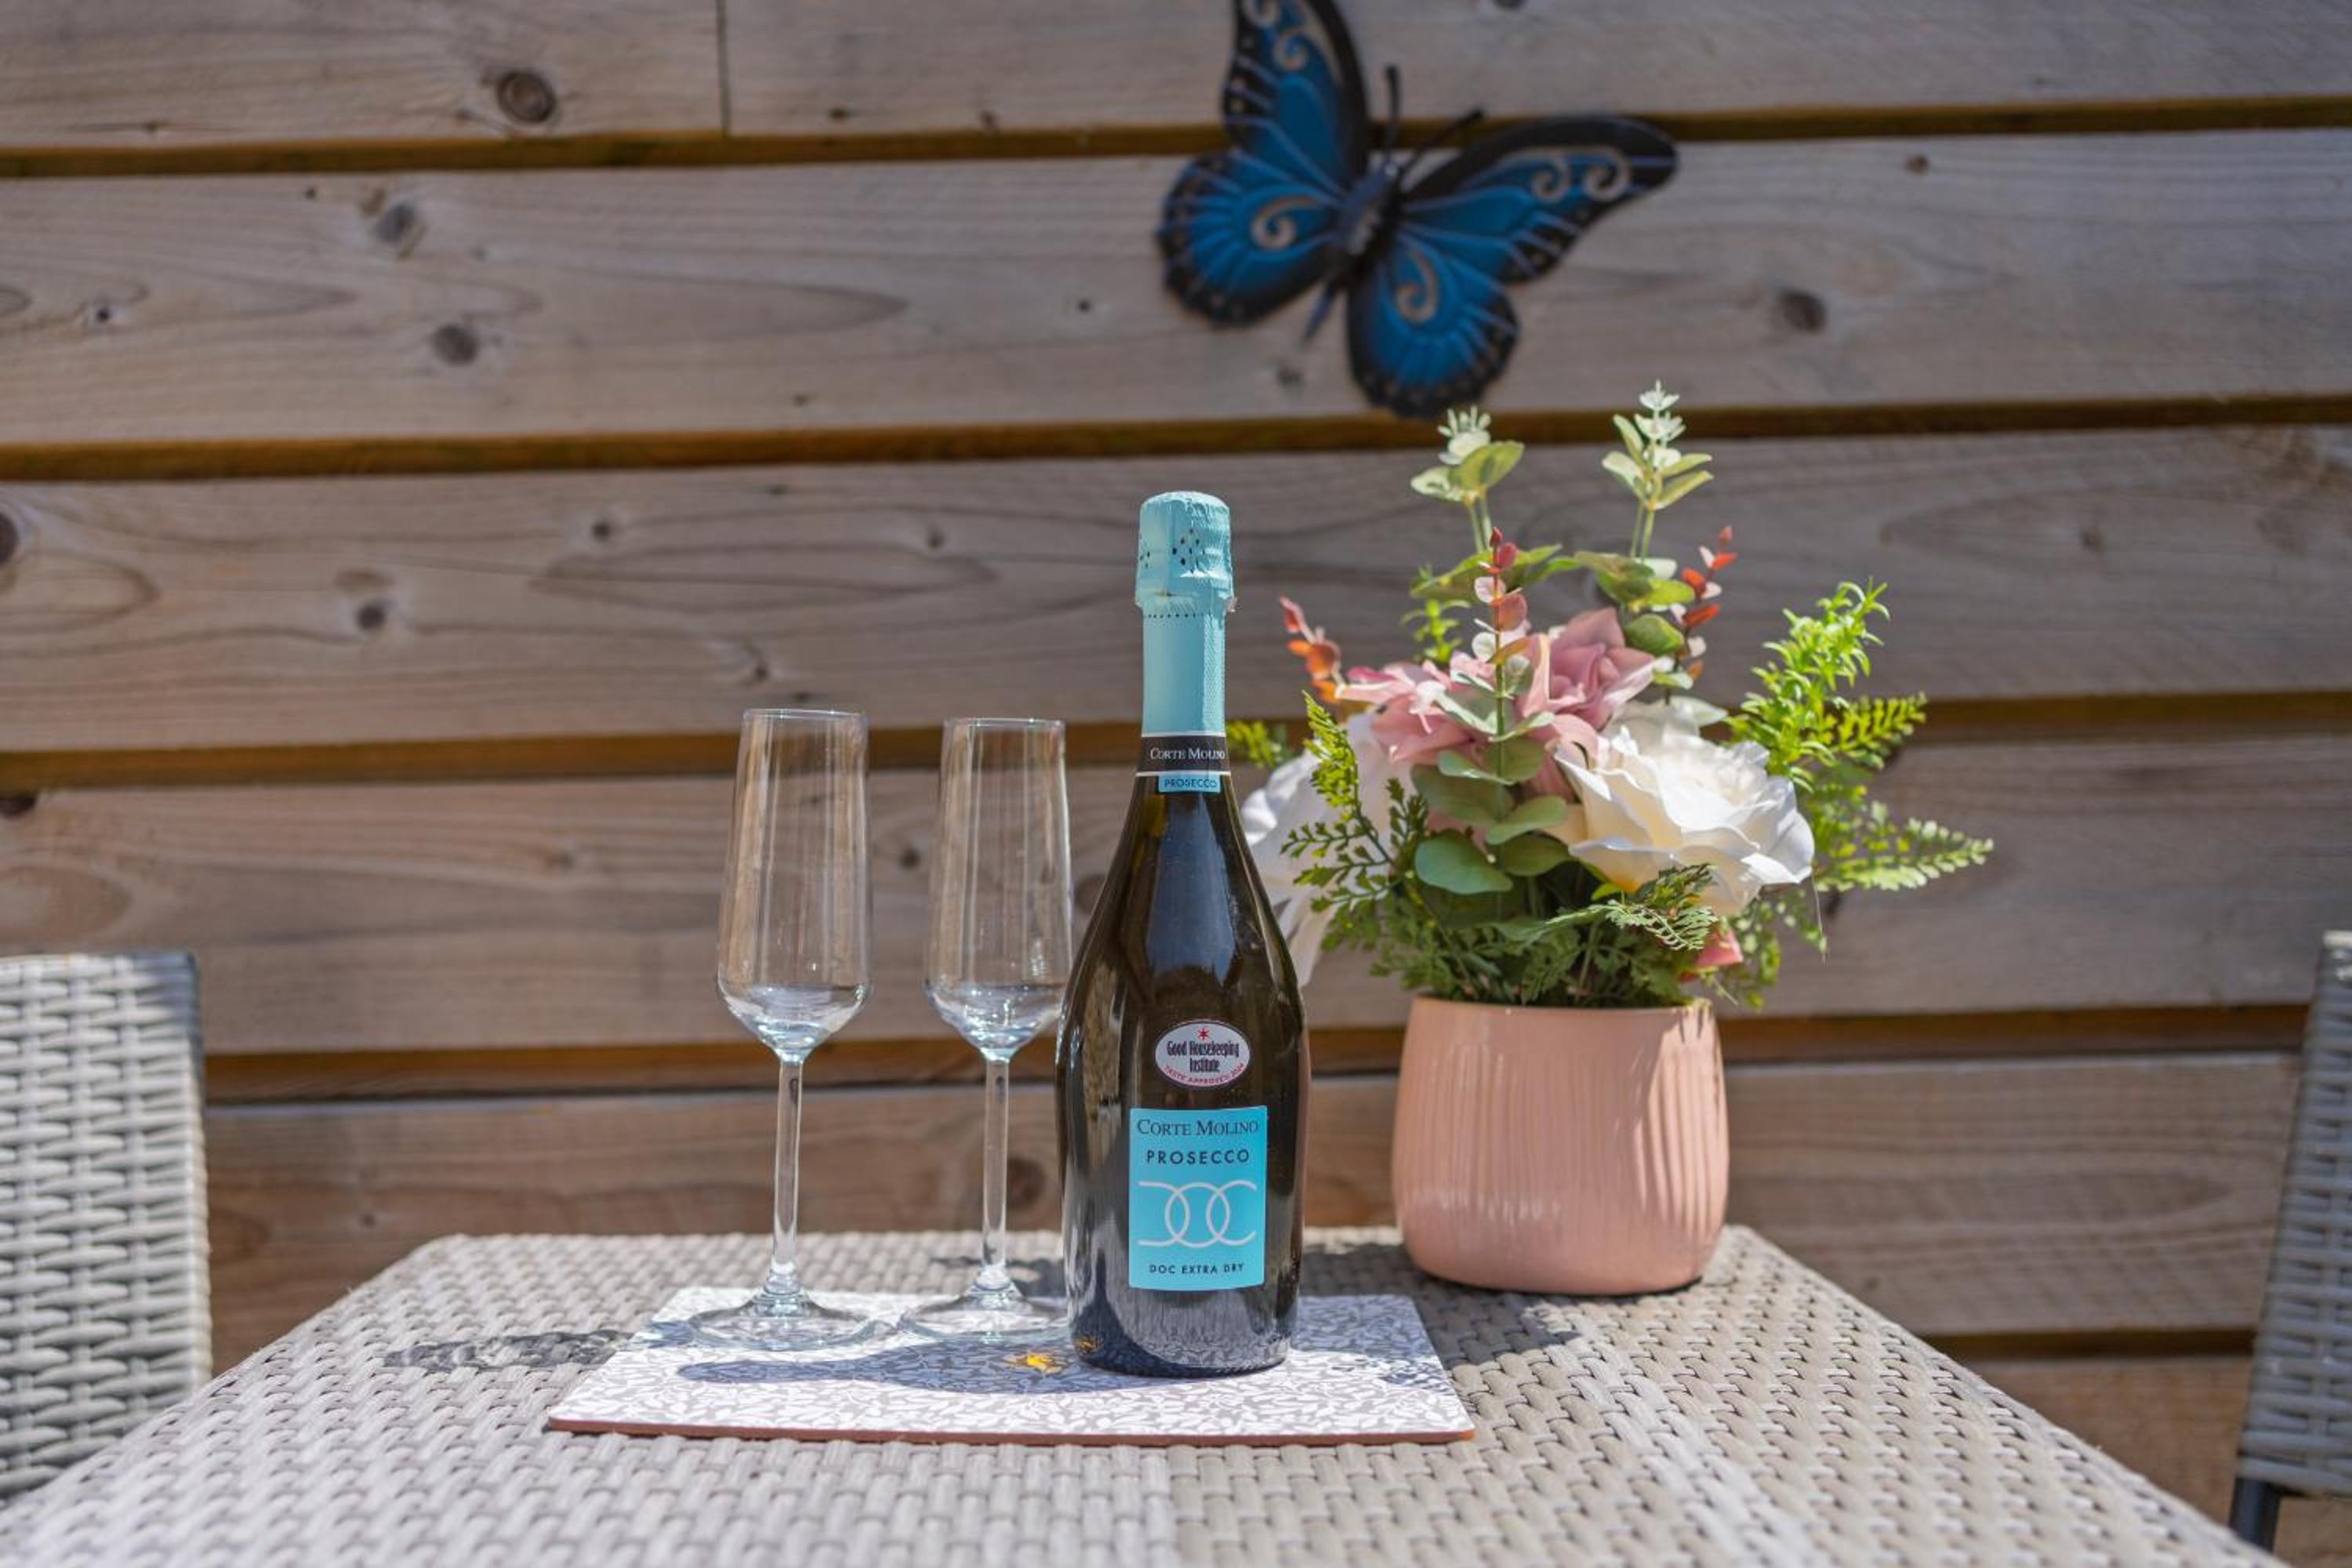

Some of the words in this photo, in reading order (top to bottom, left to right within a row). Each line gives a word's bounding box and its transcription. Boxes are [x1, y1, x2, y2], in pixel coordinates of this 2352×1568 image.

[1150, 747, 1185, 760] CORTE
[1164, 779, 1218, 788] PROSECCO
[1167, 1040, 1187, 1056] Good
[1190, 1040, 1240, 1058] Housekeeping
[1189, 1058, 1220, 1073] Institute
[1138, 1119, 1192, 1136] CORTE
[1196, 1120, 1259, 1136] MOLINO
[1147, 1149, 1250, 1164] PROSECCO
[1149, 1265, 1176, 1274] DOC
[1181, 1264, 1218, 1274] EXTRA
[1224, 1263, 1244, 1273] DRY
